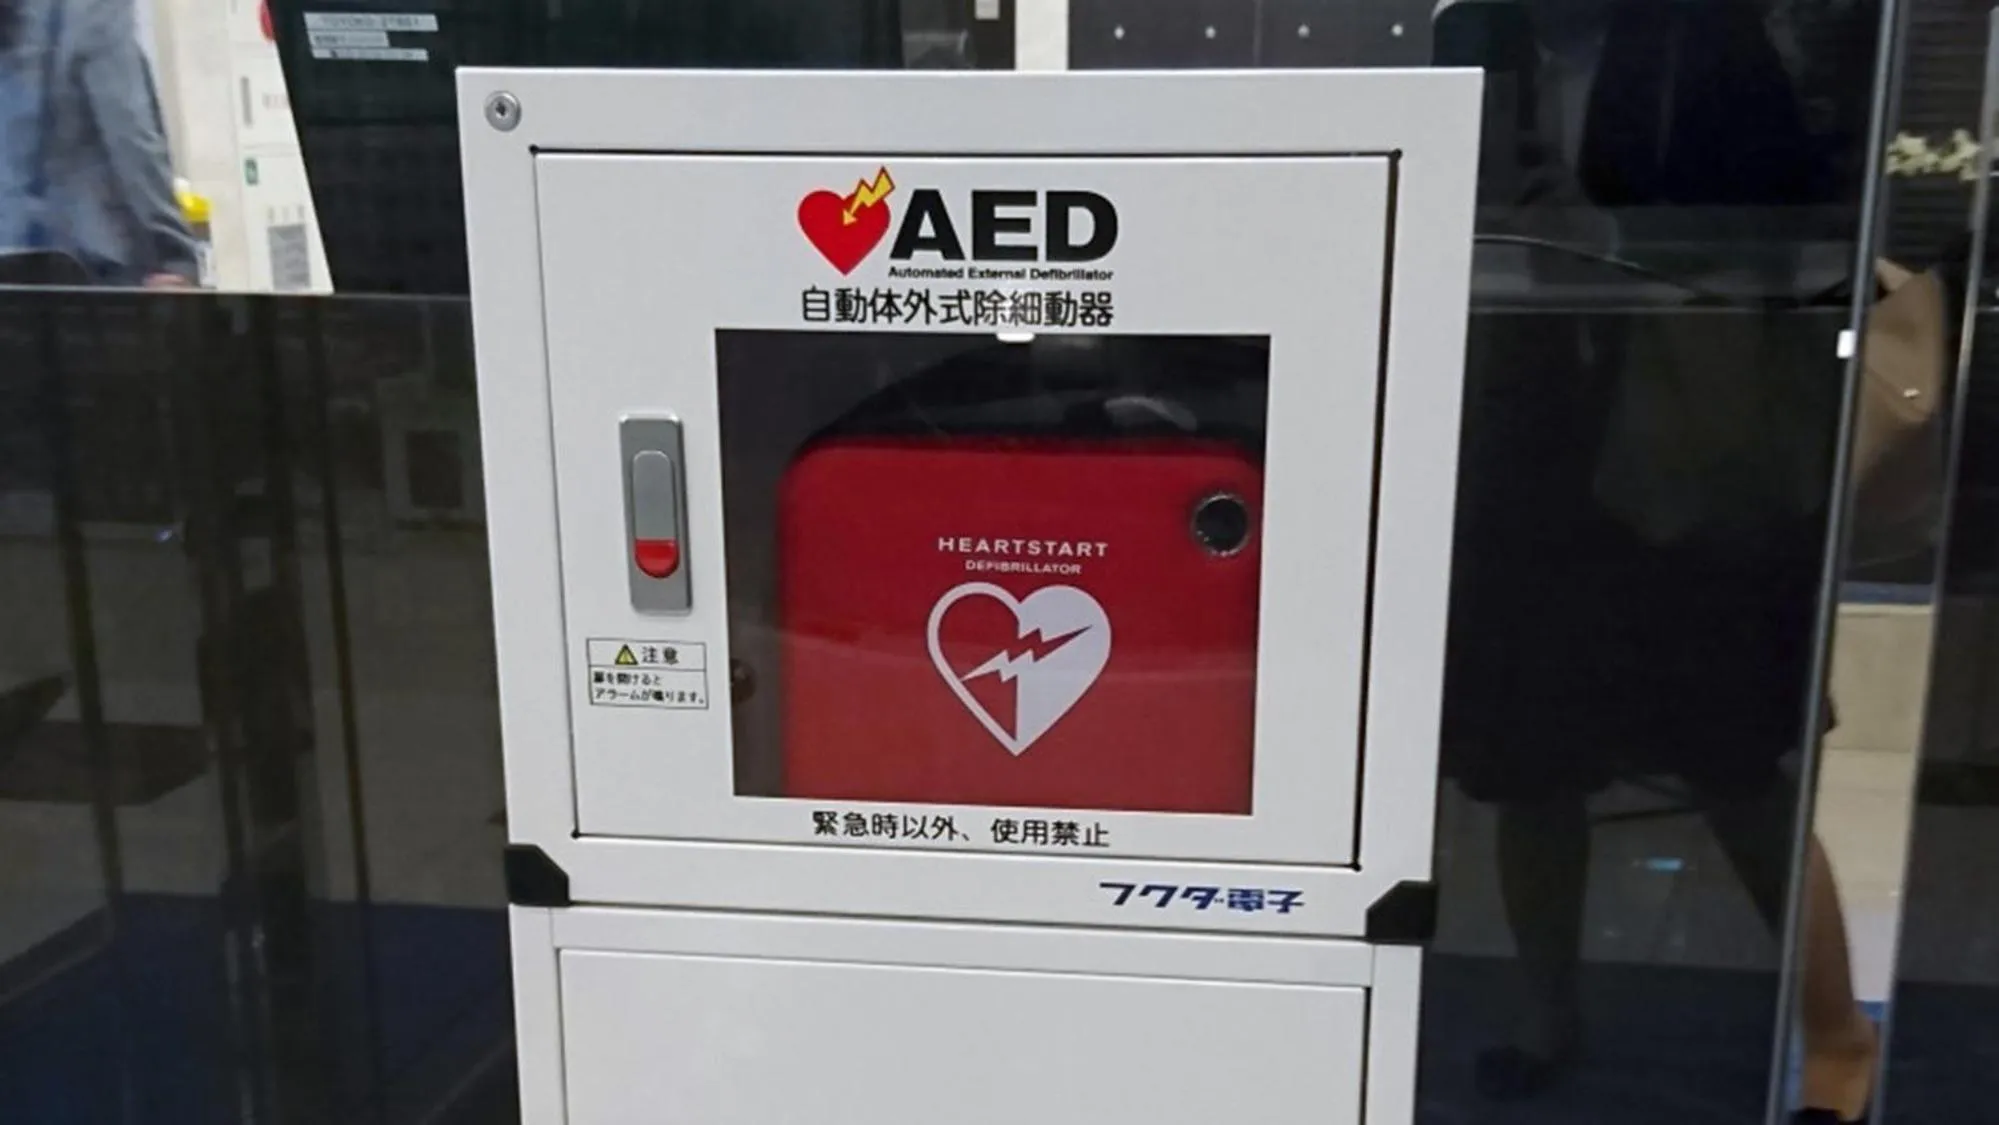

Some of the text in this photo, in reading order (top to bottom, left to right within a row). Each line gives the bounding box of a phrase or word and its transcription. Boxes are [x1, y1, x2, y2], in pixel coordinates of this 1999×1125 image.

[889, 188, 1119, 263] AED
[888, 266, 1114, 281] Automated External Defibrillator
[801, 286, 1114, 327] 自動体外式除細動器
[938, 537, 1109, 557] HEARTSTART
[965, 559, 1082, 575] DEFIBRILLATOR
[1099, 882, 1305, 914] フクダ電子
